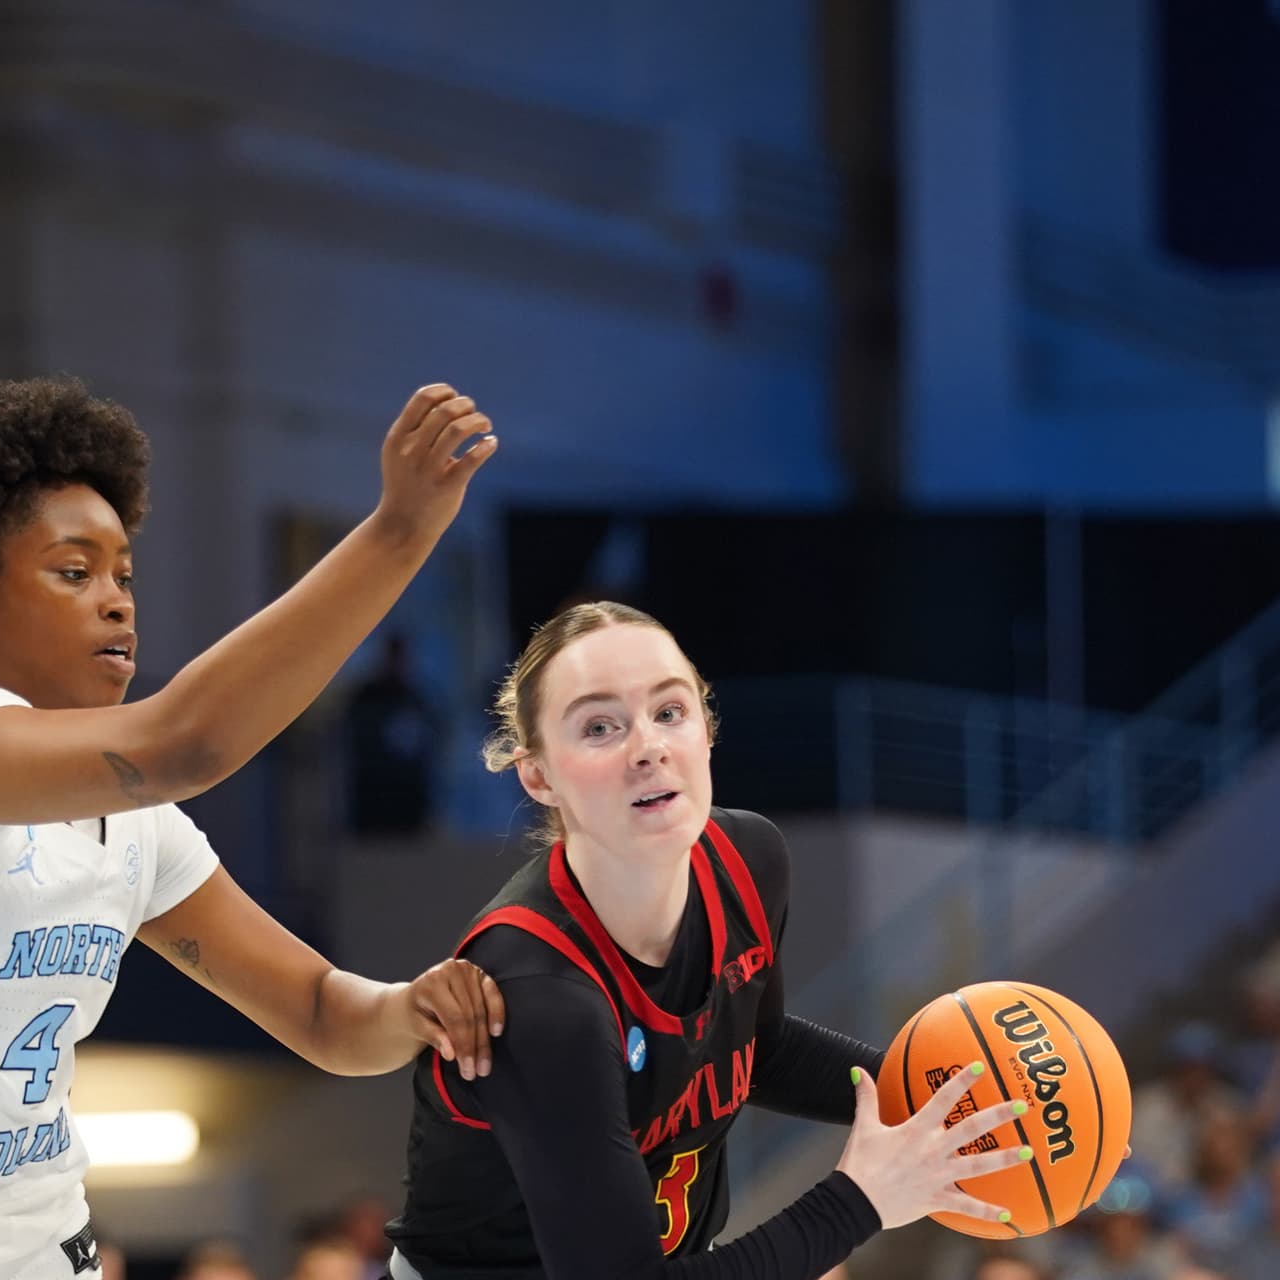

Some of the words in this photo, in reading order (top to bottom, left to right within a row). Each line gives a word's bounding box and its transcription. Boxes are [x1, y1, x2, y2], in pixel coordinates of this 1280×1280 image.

[0, 1003, 75, 1104] 4
[992, 1000, 1075, 1165] Wilson
[1009, 1057, 1024, 1080] EVO
[1021, 1084, 1036, 1108] NXT
